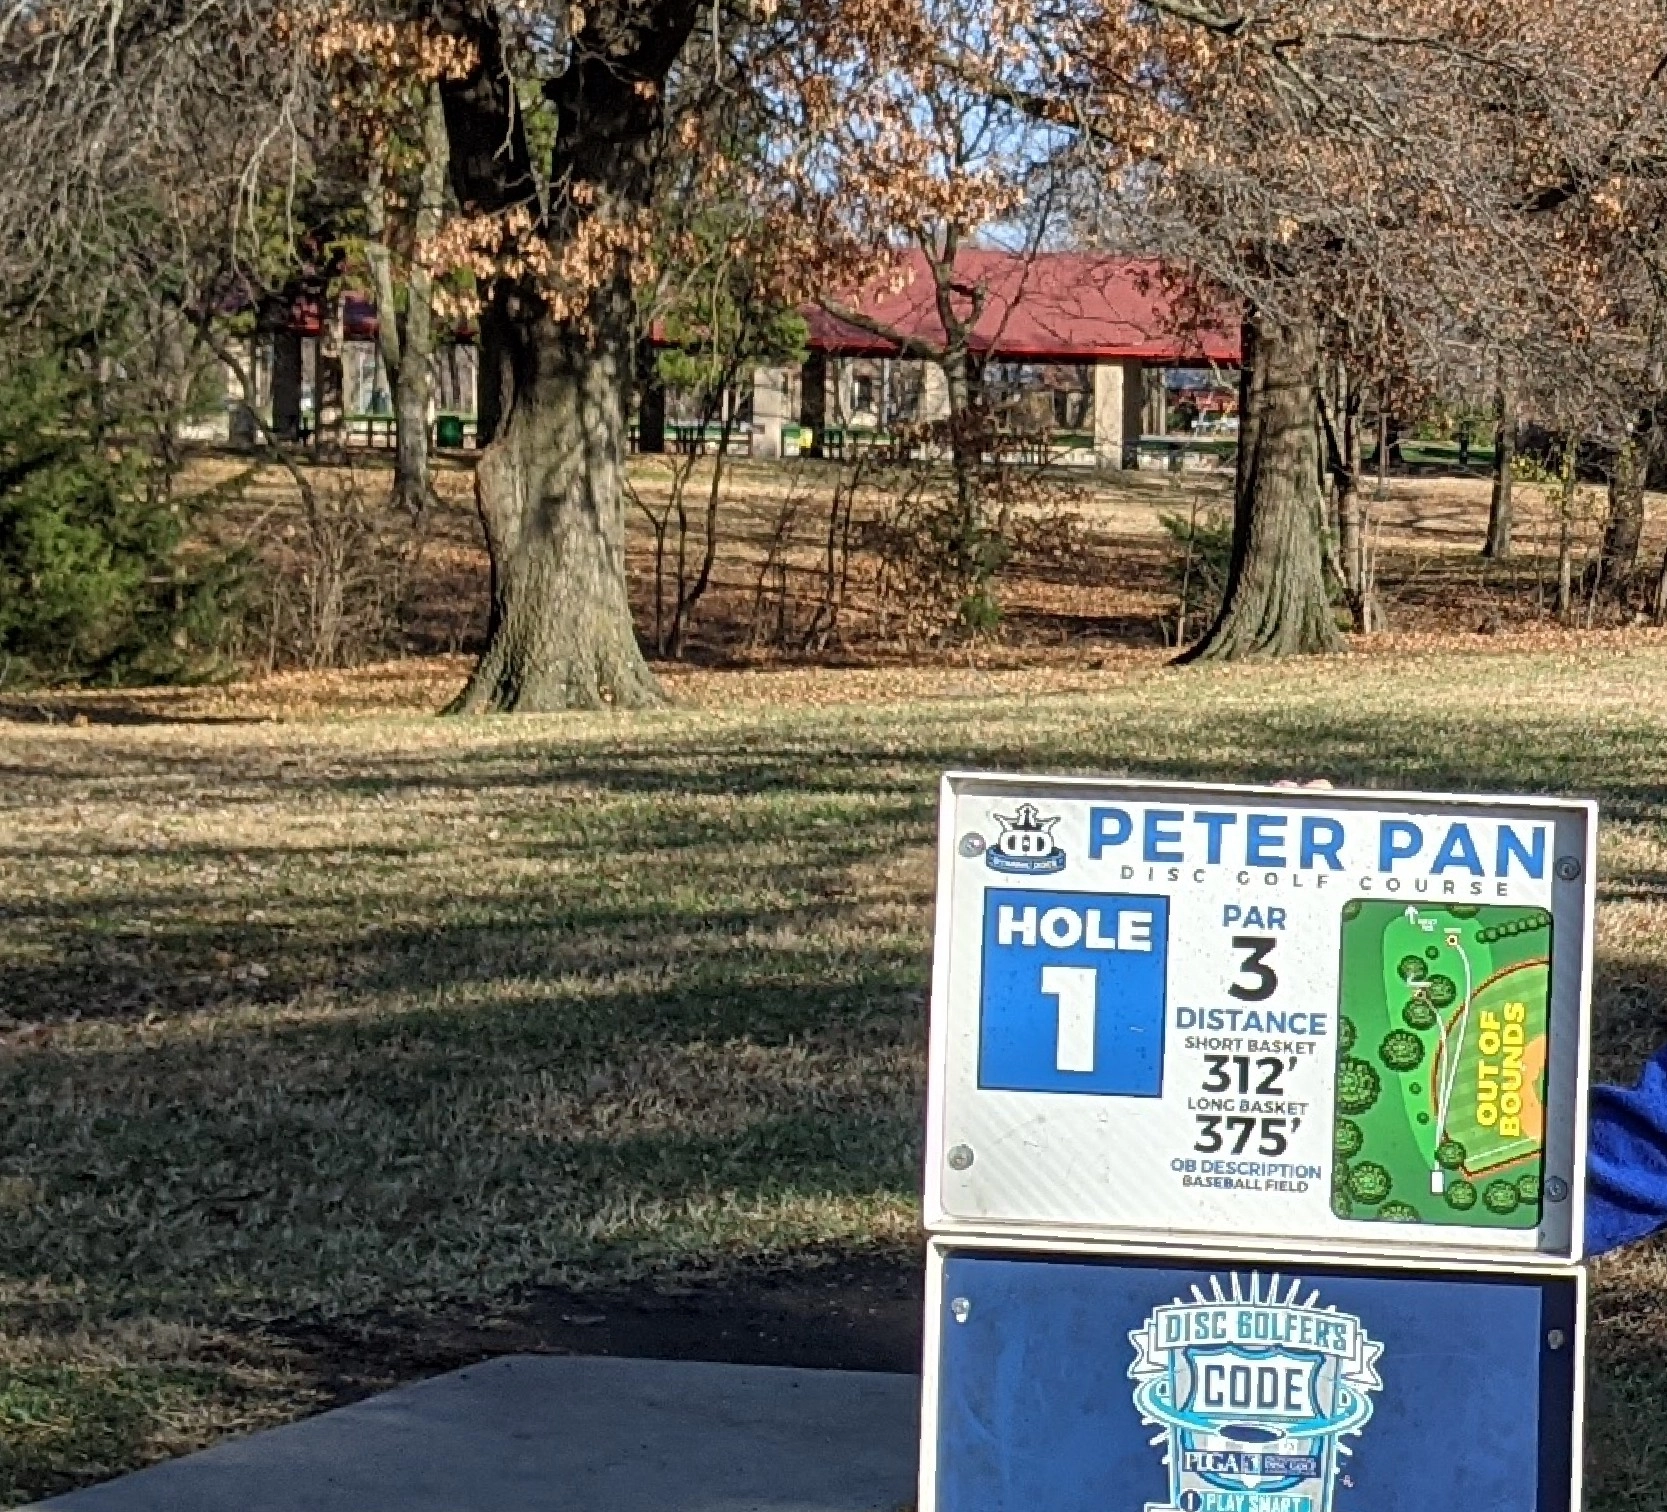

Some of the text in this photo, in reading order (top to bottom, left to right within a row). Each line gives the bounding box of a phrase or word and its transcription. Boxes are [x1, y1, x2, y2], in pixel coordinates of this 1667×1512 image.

[1088, 806, 1546, 880] PETER PAN
[1120, 864, 1508, 897] DISC GOLF COURSE
[997, 904, 1153, 952] HOLE
[1222, 904, 1287, 931] PAR
[1228, 935, 1278, 1002] 3
[1041, 966, 1097, 1072] 1
[1176, 1006, 1328, 1036] DISTANCE
[1184, 1035, 1316, 1055] SHORT BASKET
[1202, 1054, 1298, 1097] 312'
[1476, 1010, 1501, 1126] OUT OF
[1499, 1002, 1525, 1137] BOUNDS
[1187, 1096, 1309, 1116] LONG BASKET
[1194, 1113, 1302, 1157] 375'
[1170, 1157, 1322, 1179] OB DESCRIPTION
[1182, 1174, 1309, 1194] BASEBALL FIELD
[1165, 1310, 1227, 1343] DISC
[1204, 1364, 1305, 1412] CODE
